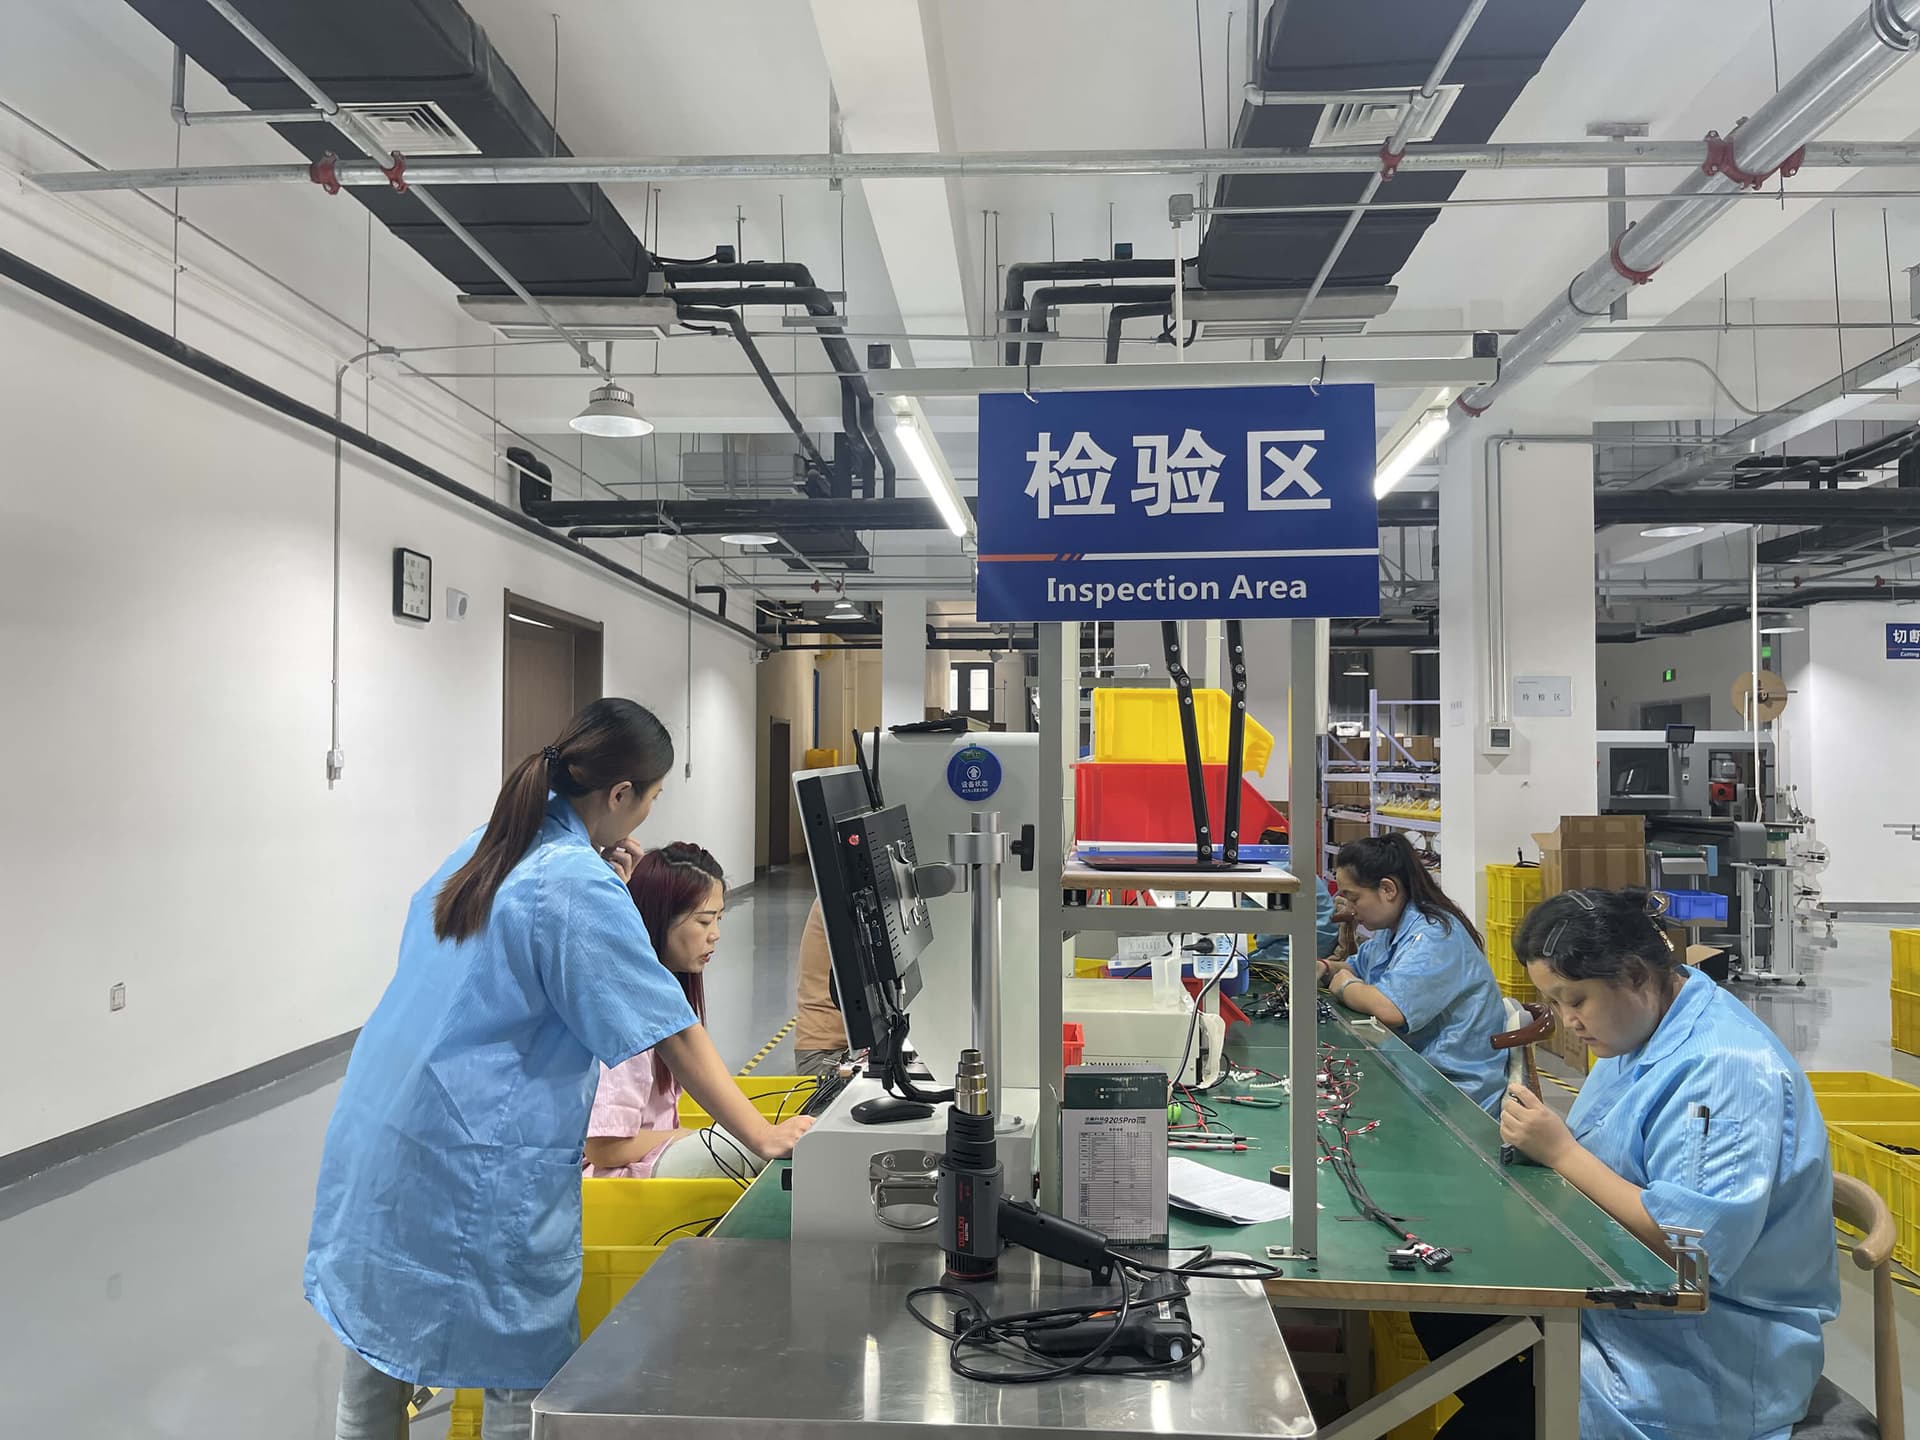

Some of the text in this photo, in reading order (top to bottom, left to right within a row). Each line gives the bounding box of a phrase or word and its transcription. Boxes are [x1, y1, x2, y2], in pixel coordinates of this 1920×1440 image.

[1024, 428, 1331, 519] 检验区
[1047, 575, 1307, 608] Inspection Area
[960, 780, 989, 788] 设备状态
